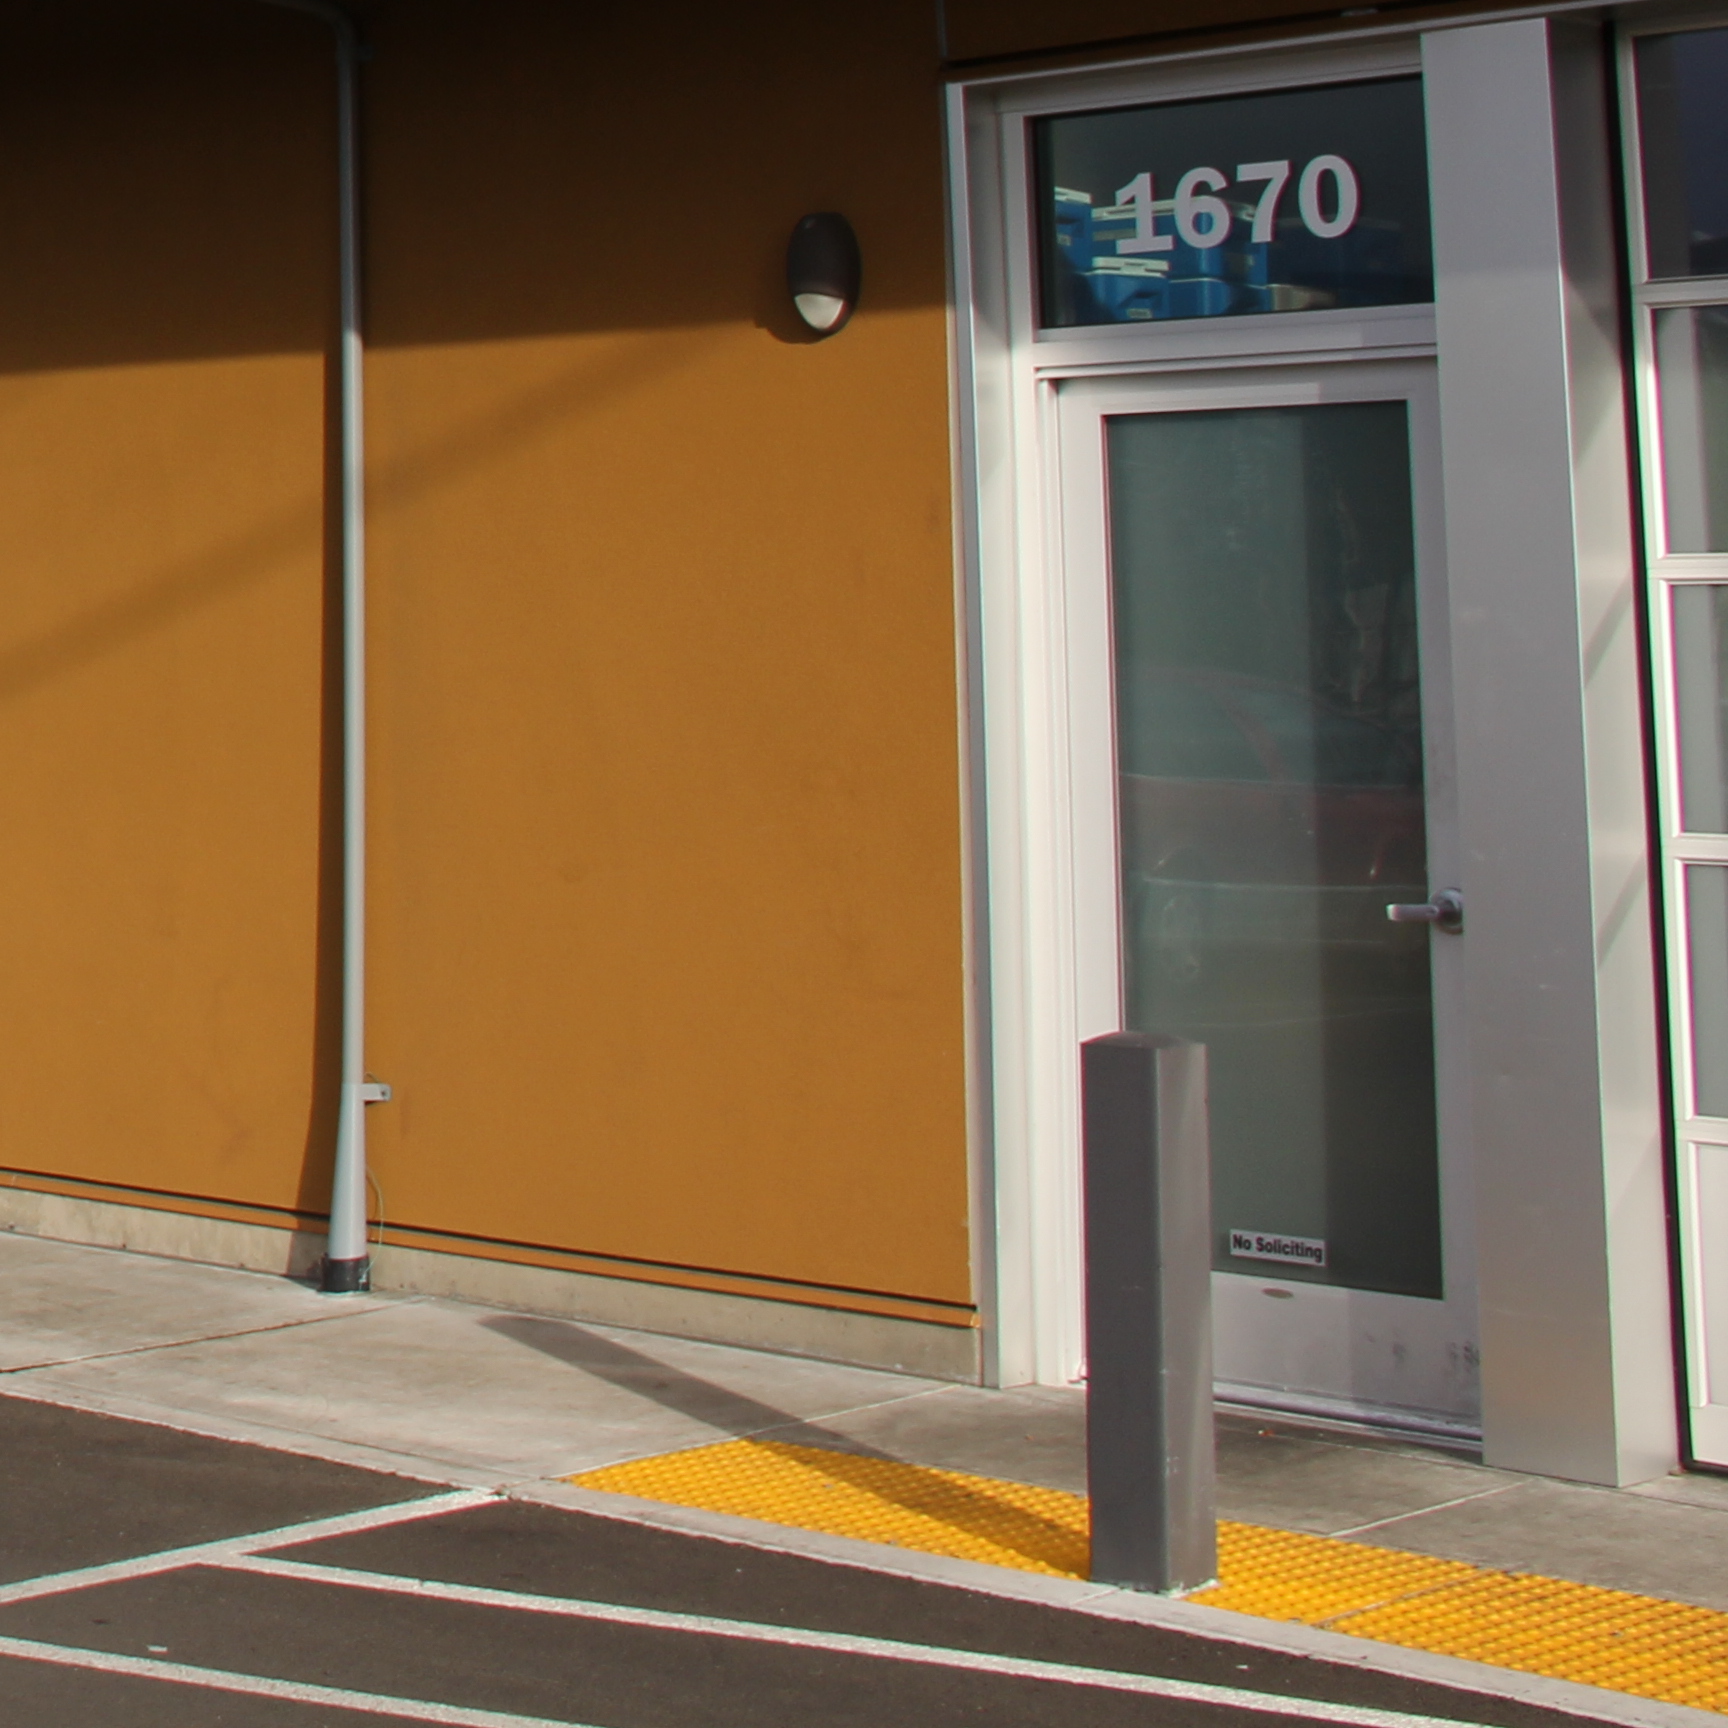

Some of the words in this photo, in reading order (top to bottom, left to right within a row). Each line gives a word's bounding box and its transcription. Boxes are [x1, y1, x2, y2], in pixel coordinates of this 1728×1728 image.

[1115, 154, 1360, 255] 1670
[1233, 1234, 1251, 1250] No
[1255, 1236, 1323, 1264] Soliciting
